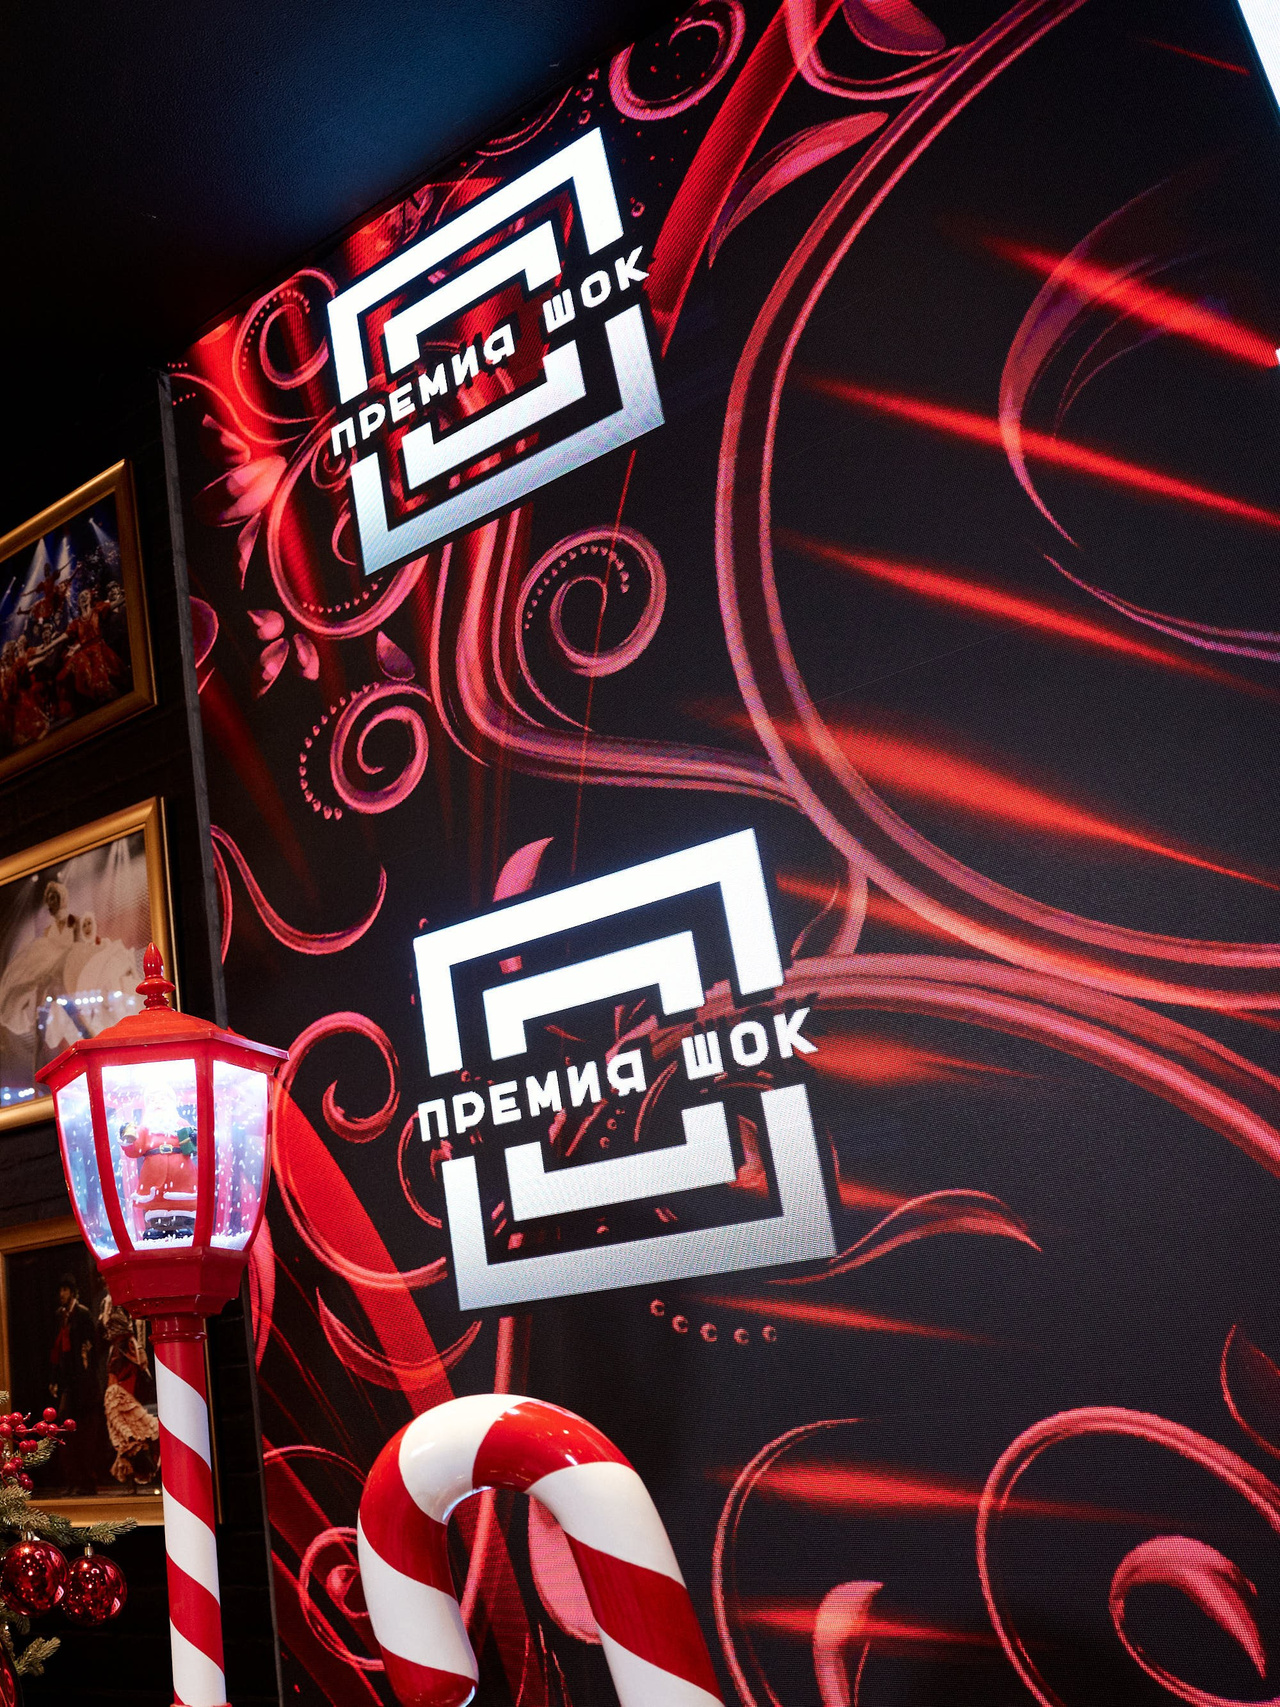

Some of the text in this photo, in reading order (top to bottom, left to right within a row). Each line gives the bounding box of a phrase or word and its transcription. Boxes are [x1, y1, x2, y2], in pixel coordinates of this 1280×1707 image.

[331, 245, 650, 457] ПРЕМИЯ ШОК
[417, 1006, 819, 1142] ПРЕМИЯ ШОК
